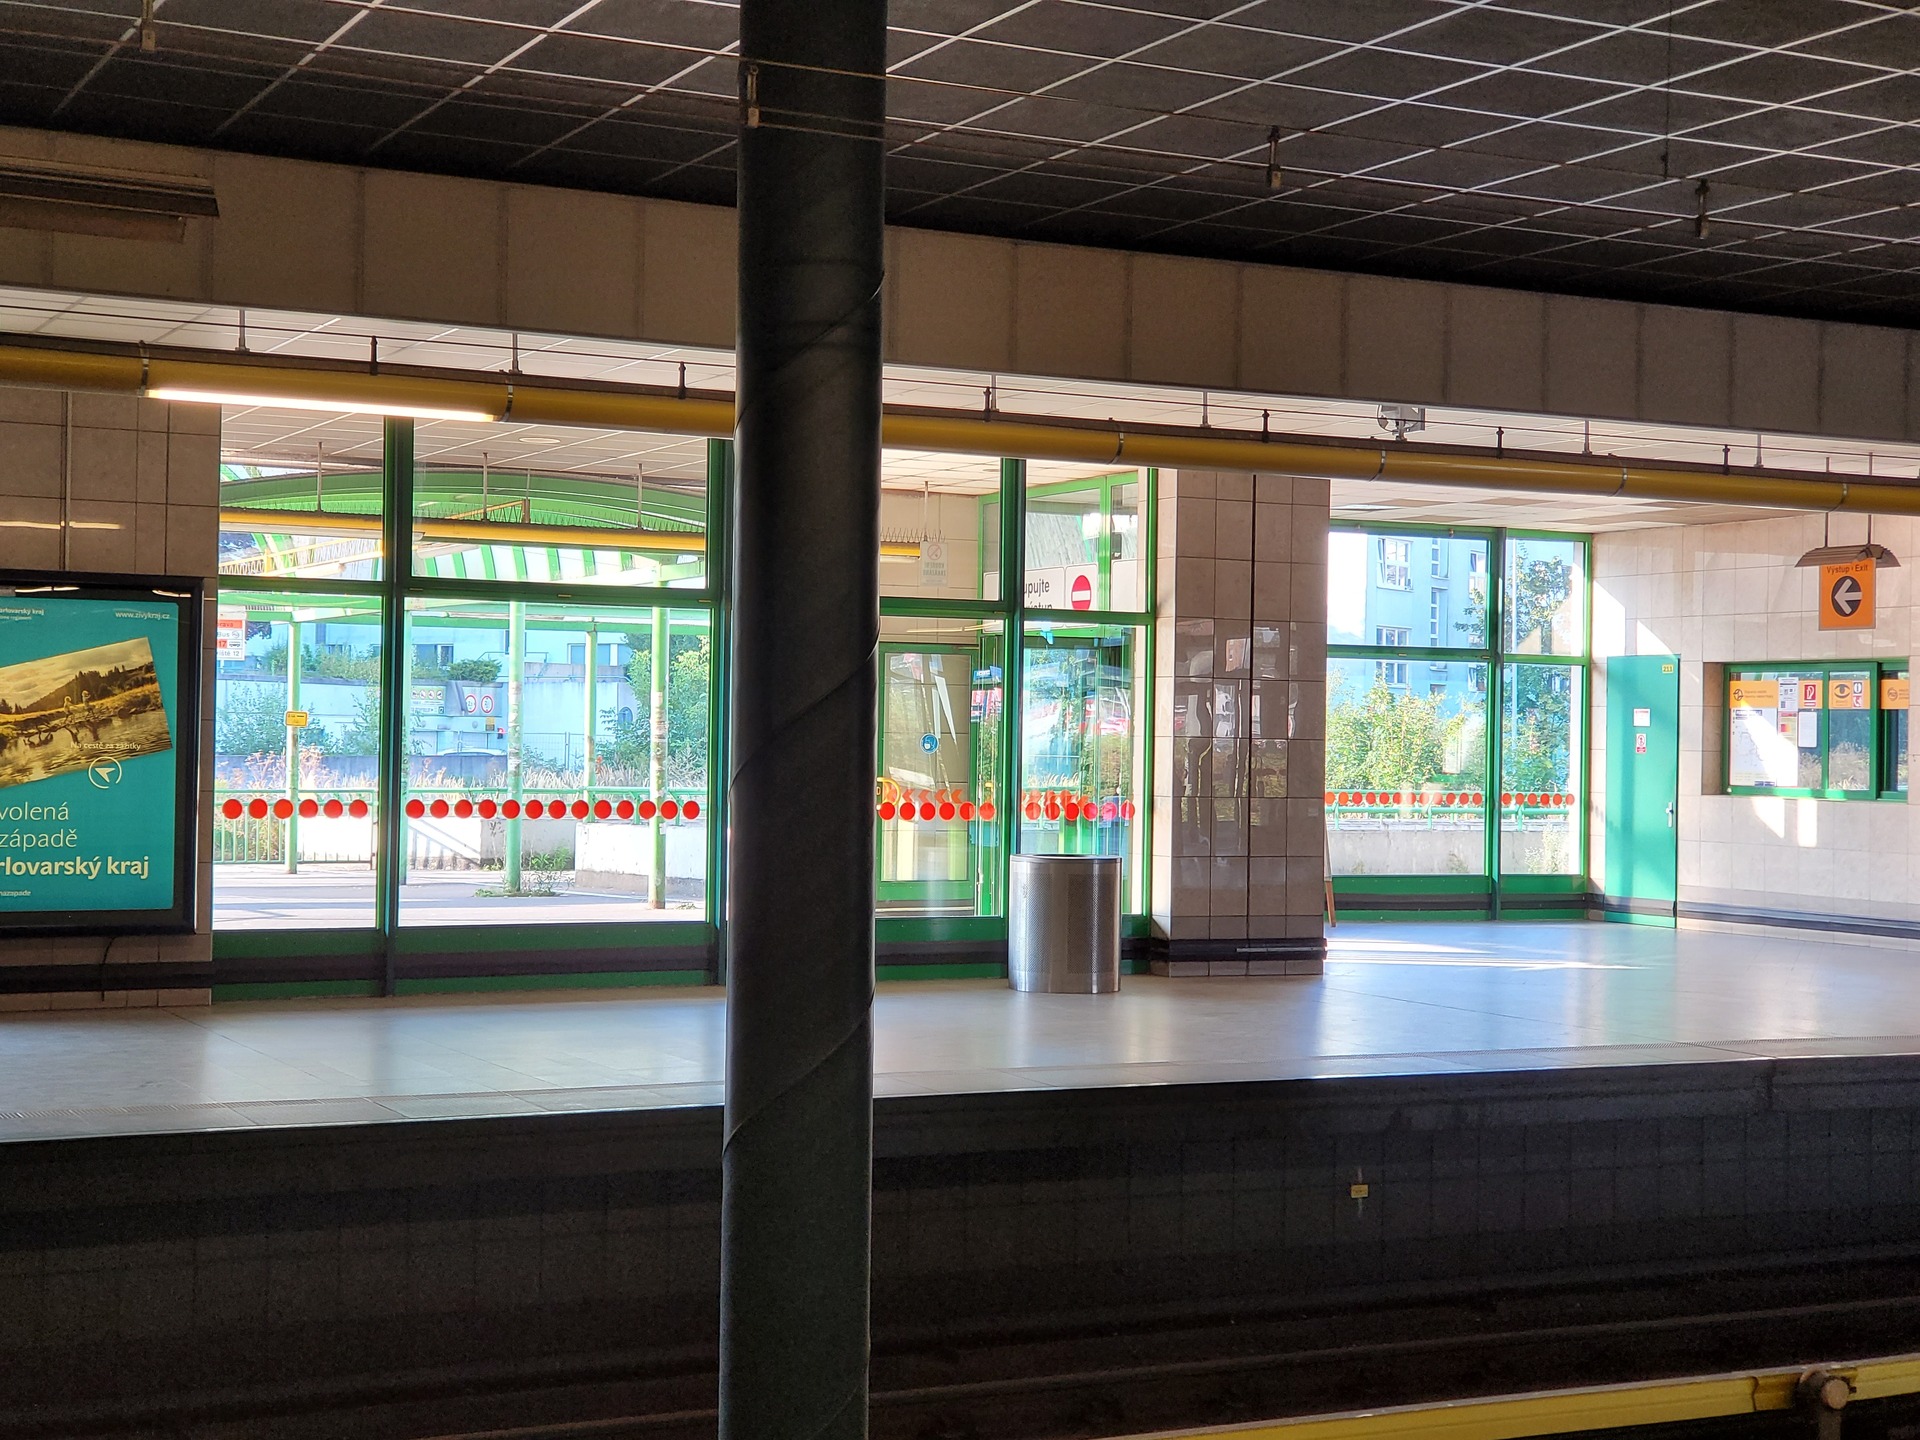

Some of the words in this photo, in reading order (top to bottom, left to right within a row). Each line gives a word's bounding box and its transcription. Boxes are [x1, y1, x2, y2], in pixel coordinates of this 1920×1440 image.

[1826, 565, 1850, 575] Výstup
[1855, 563, 1868, 572] Exit
[0, 828, 78, 852] západě
[107, 856, 149, 879] kraj
